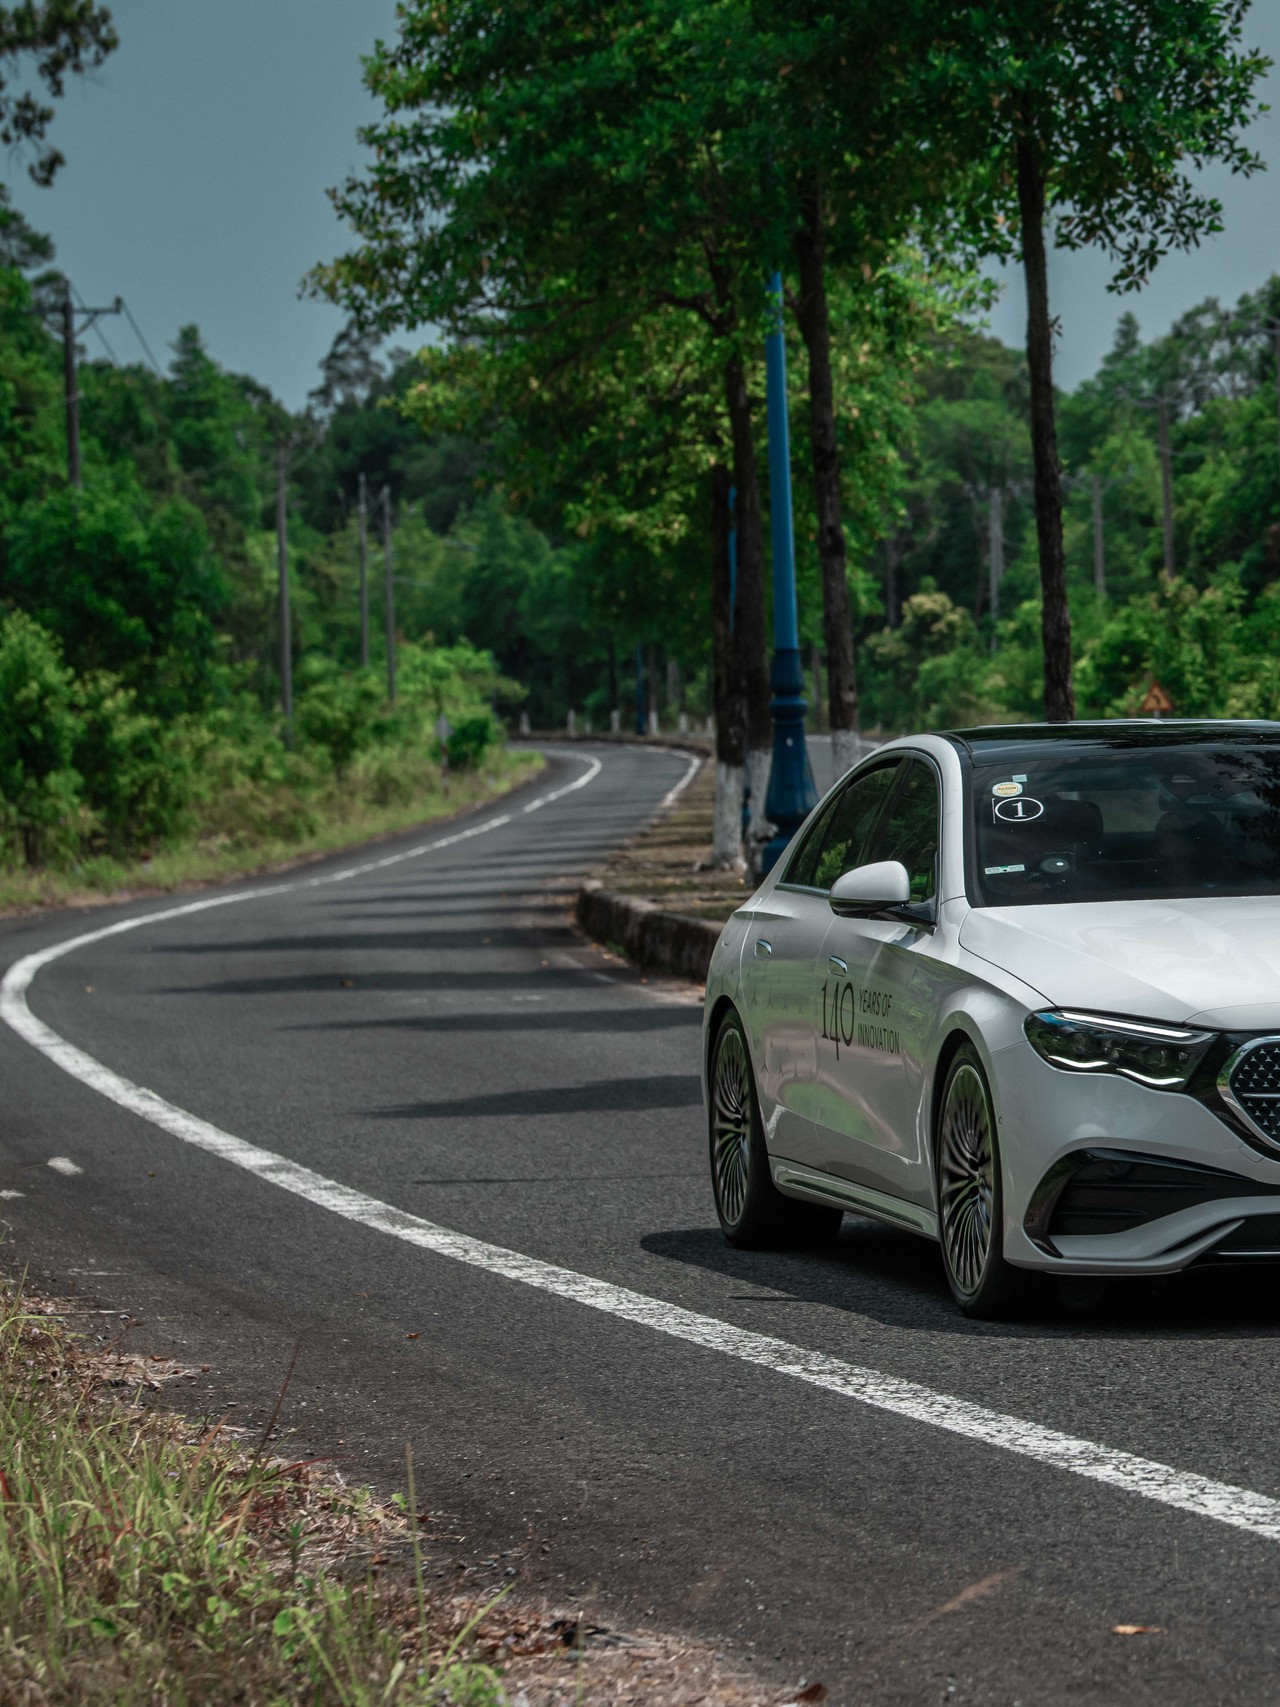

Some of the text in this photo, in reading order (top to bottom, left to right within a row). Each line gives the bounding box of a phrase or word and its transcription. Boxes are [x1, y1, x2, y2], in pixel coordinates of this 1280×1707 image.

[1012, 801, 1027, 818] 1
[859, 988, 893, 1018] YEARS OF
[821, 979, 855, 1061] 140
[857, 1022, 900, 1055] INNOVATION
